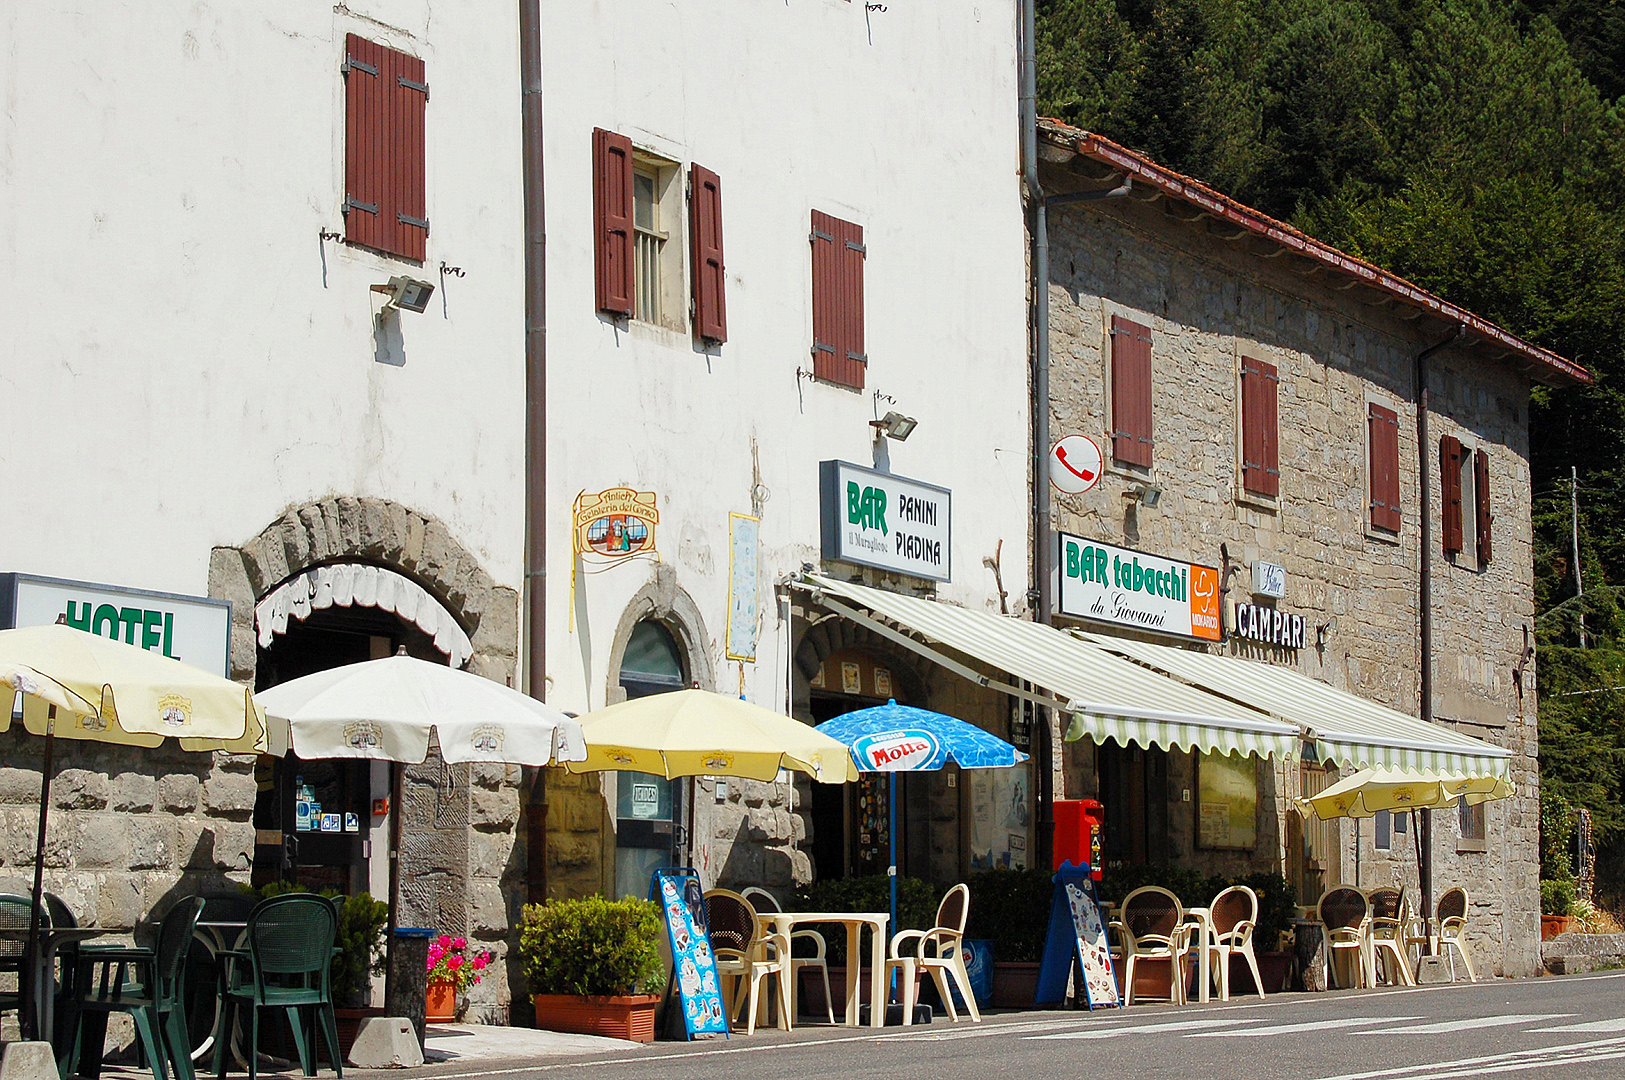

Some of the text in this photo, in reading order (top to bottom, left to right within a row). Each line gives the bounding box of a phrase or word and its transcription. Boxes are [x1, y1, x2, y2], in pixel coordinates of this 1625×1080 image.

[847, 480, 888, 537] BAR
[899, 494, 937, 527] PANINI
[895, 531, 941, 566] PIADINA
[1066, 541, 1187, 603] BAR tabacchi
[66, 600, 181, 662] HOTEL
[1090, 591, 1168, 628] da Giovanni
[1238, 603, 1306, 650] CAMPARI
